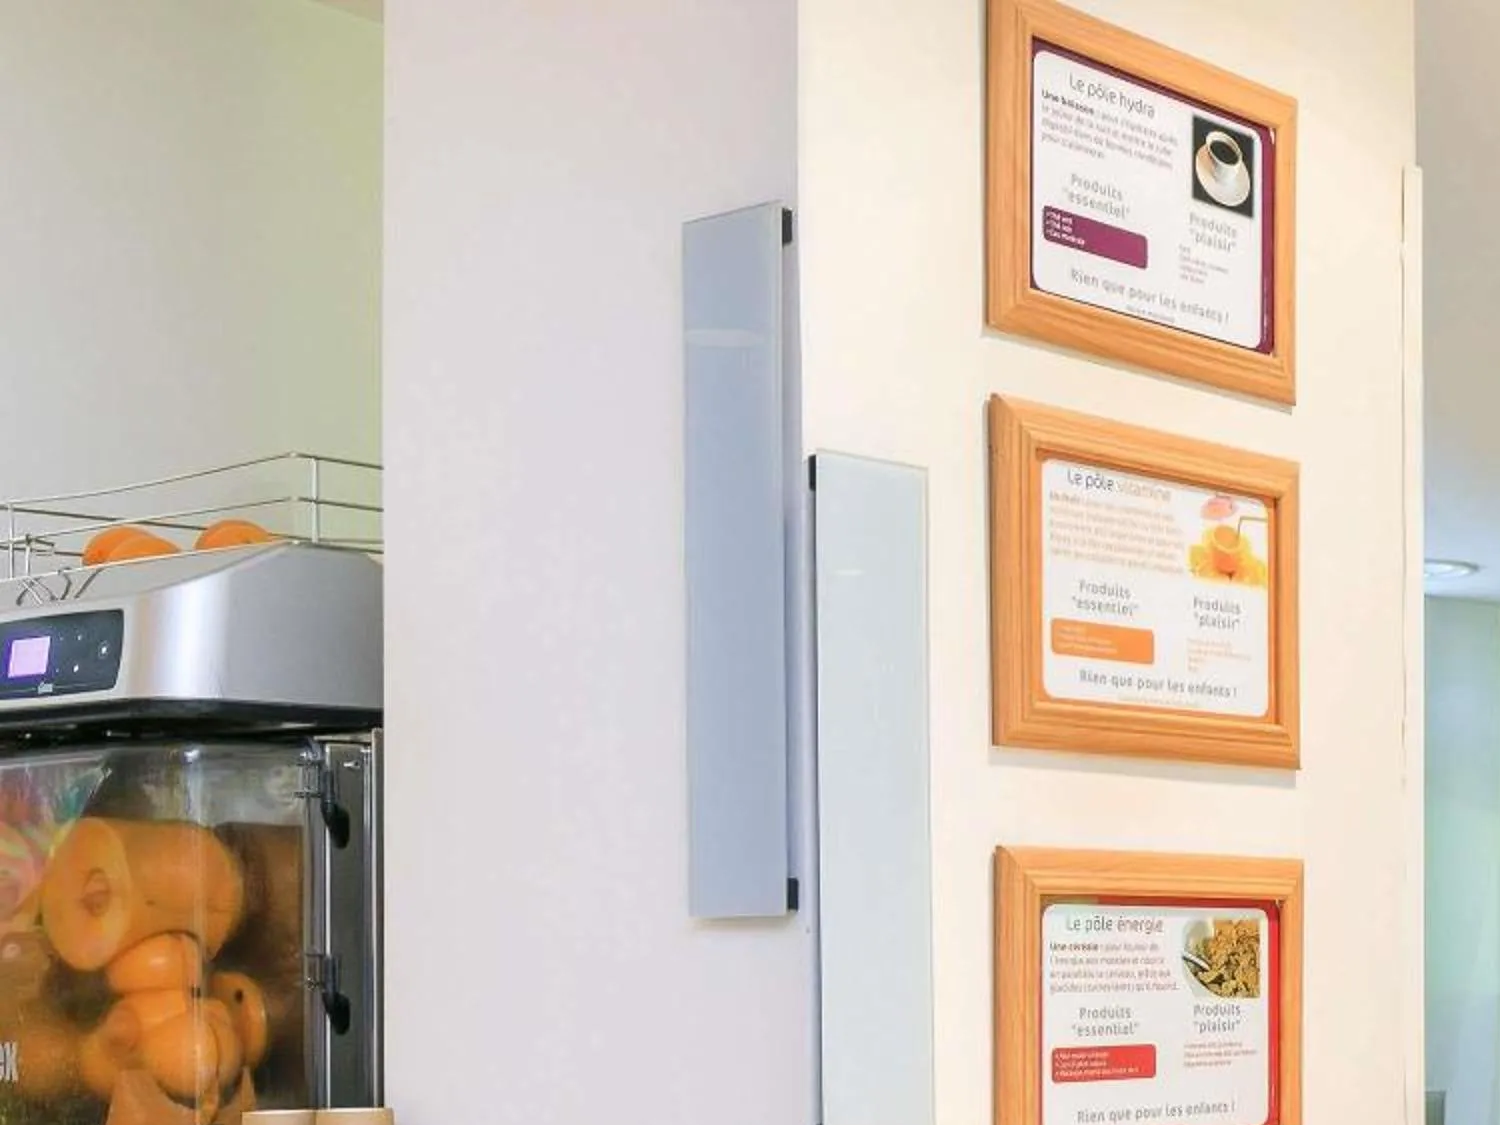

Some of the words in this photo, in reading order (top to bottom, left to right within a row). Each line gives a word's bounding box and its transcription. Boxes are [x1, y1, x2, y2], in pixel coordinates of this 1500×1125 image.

[1068, 72, 1086, 93] Le
[1119, 91, 1156, 119] hydra
[1071, 173, 1123, 201] Produits
[1189, 212, 1238, 238] Produits
[1070, 267, 1099, 288] Rien
[1102, 279, 1126, 297] que
[1129, 286, 1157, 303] pour
[1159, 292, 1177, 310] les
[1180, 301, 1223, 324] enfants
[1067, 467, 1082, 486] Le
[1085, 472, 1114, 492] pôle
[1079, 579, 1131, 600] Produits
[1193, 596, 1241, 615] Produits
[1079, 669, 1107, 686] Rien
[1111, 673, 1133, 689] que
[1137, 678, 1164, 692] pour
[1167, 678, 1185, 693] les
[1187, 681, 1231, 698] enfants
[1066, 916, 1081, 932] Le
[1085, 915, 1113, 933] pôle
[1117, 916, 1164, 935] énergie
[1079, 1006, 1132, 1019] Produits
[1193, 1003, 1241, 1017] Produits
[1077, 1109, 1105, 1124] Rien
[1109, 1109, 1131, 1124] que
[1135, 1107, 1162, 1122] pour
[1165, 1103, 1183, 1118] les
[1186, 1101, 1228, 1115] enfants
